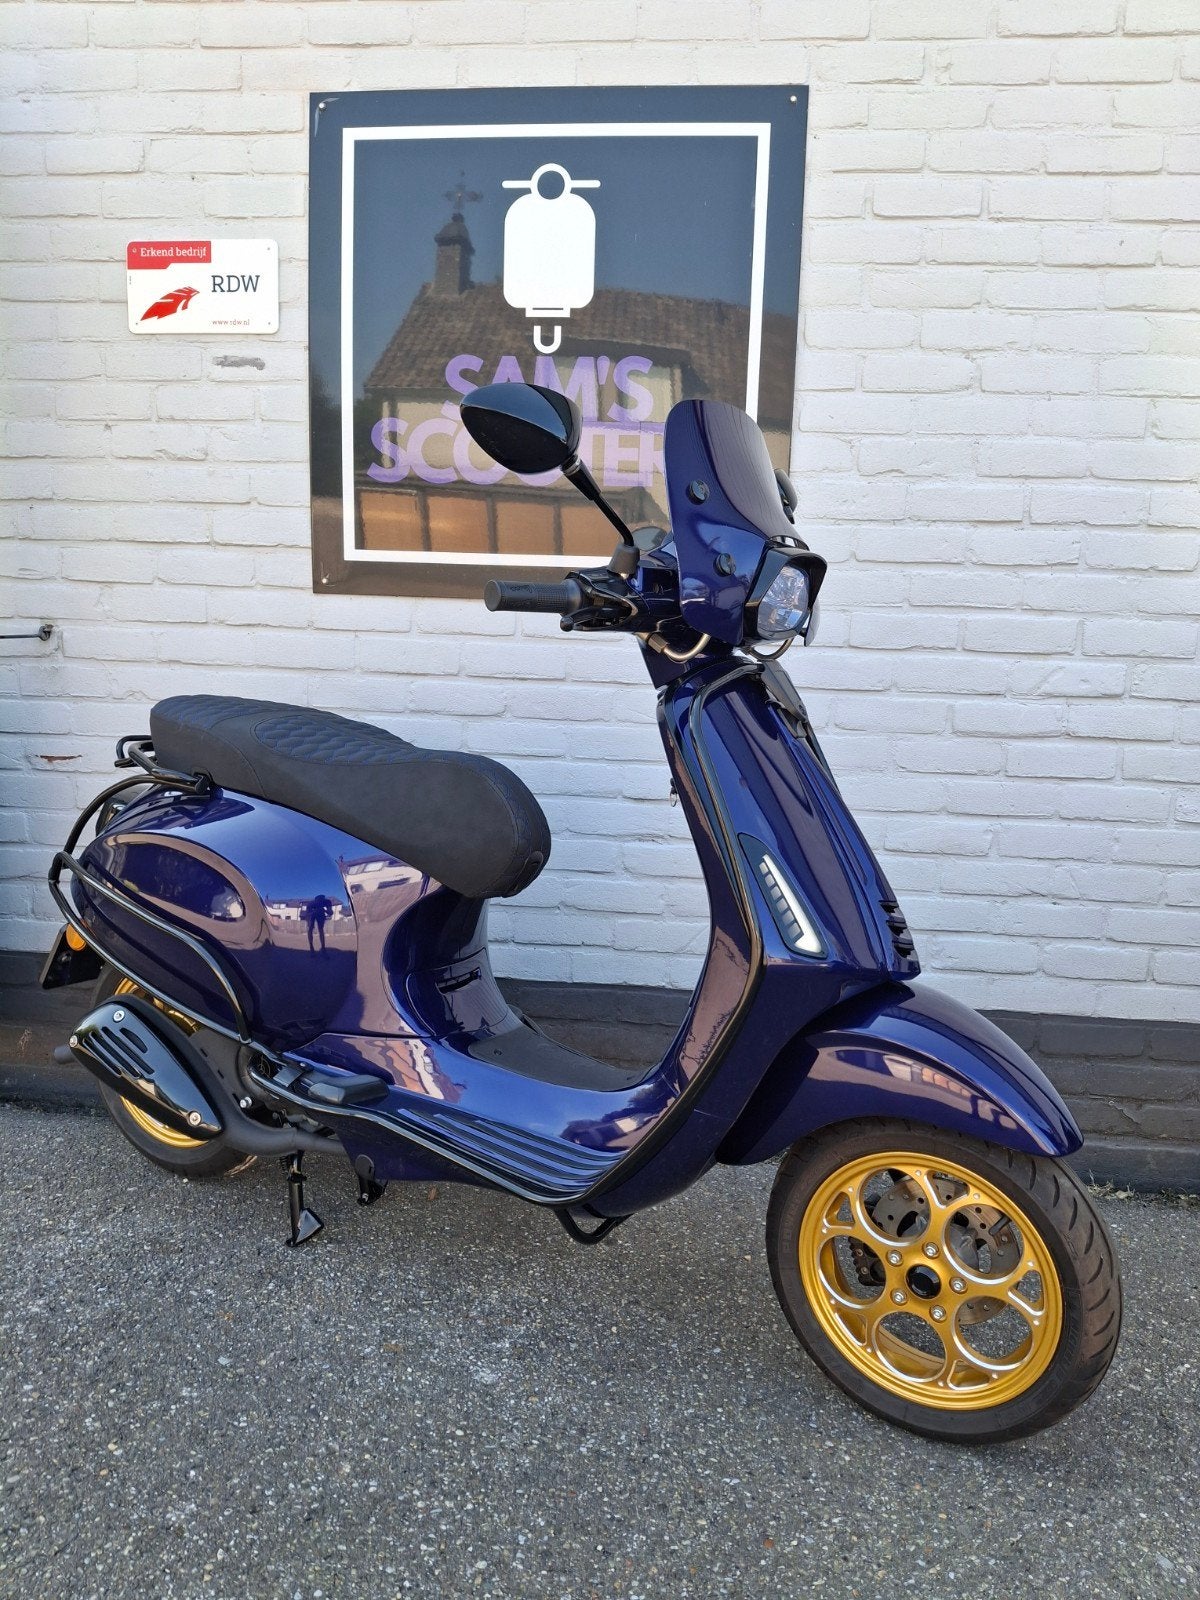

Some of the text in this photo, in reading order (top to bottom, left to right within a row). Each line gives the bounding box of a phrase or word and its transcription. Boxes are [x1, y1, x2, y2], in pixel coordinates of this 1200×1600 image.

[140, 246, 207, 259] Erkend bedrijf
[211, 274, 260, 293] RDW
[212, 318, 250, 326] www.rdw.nl
